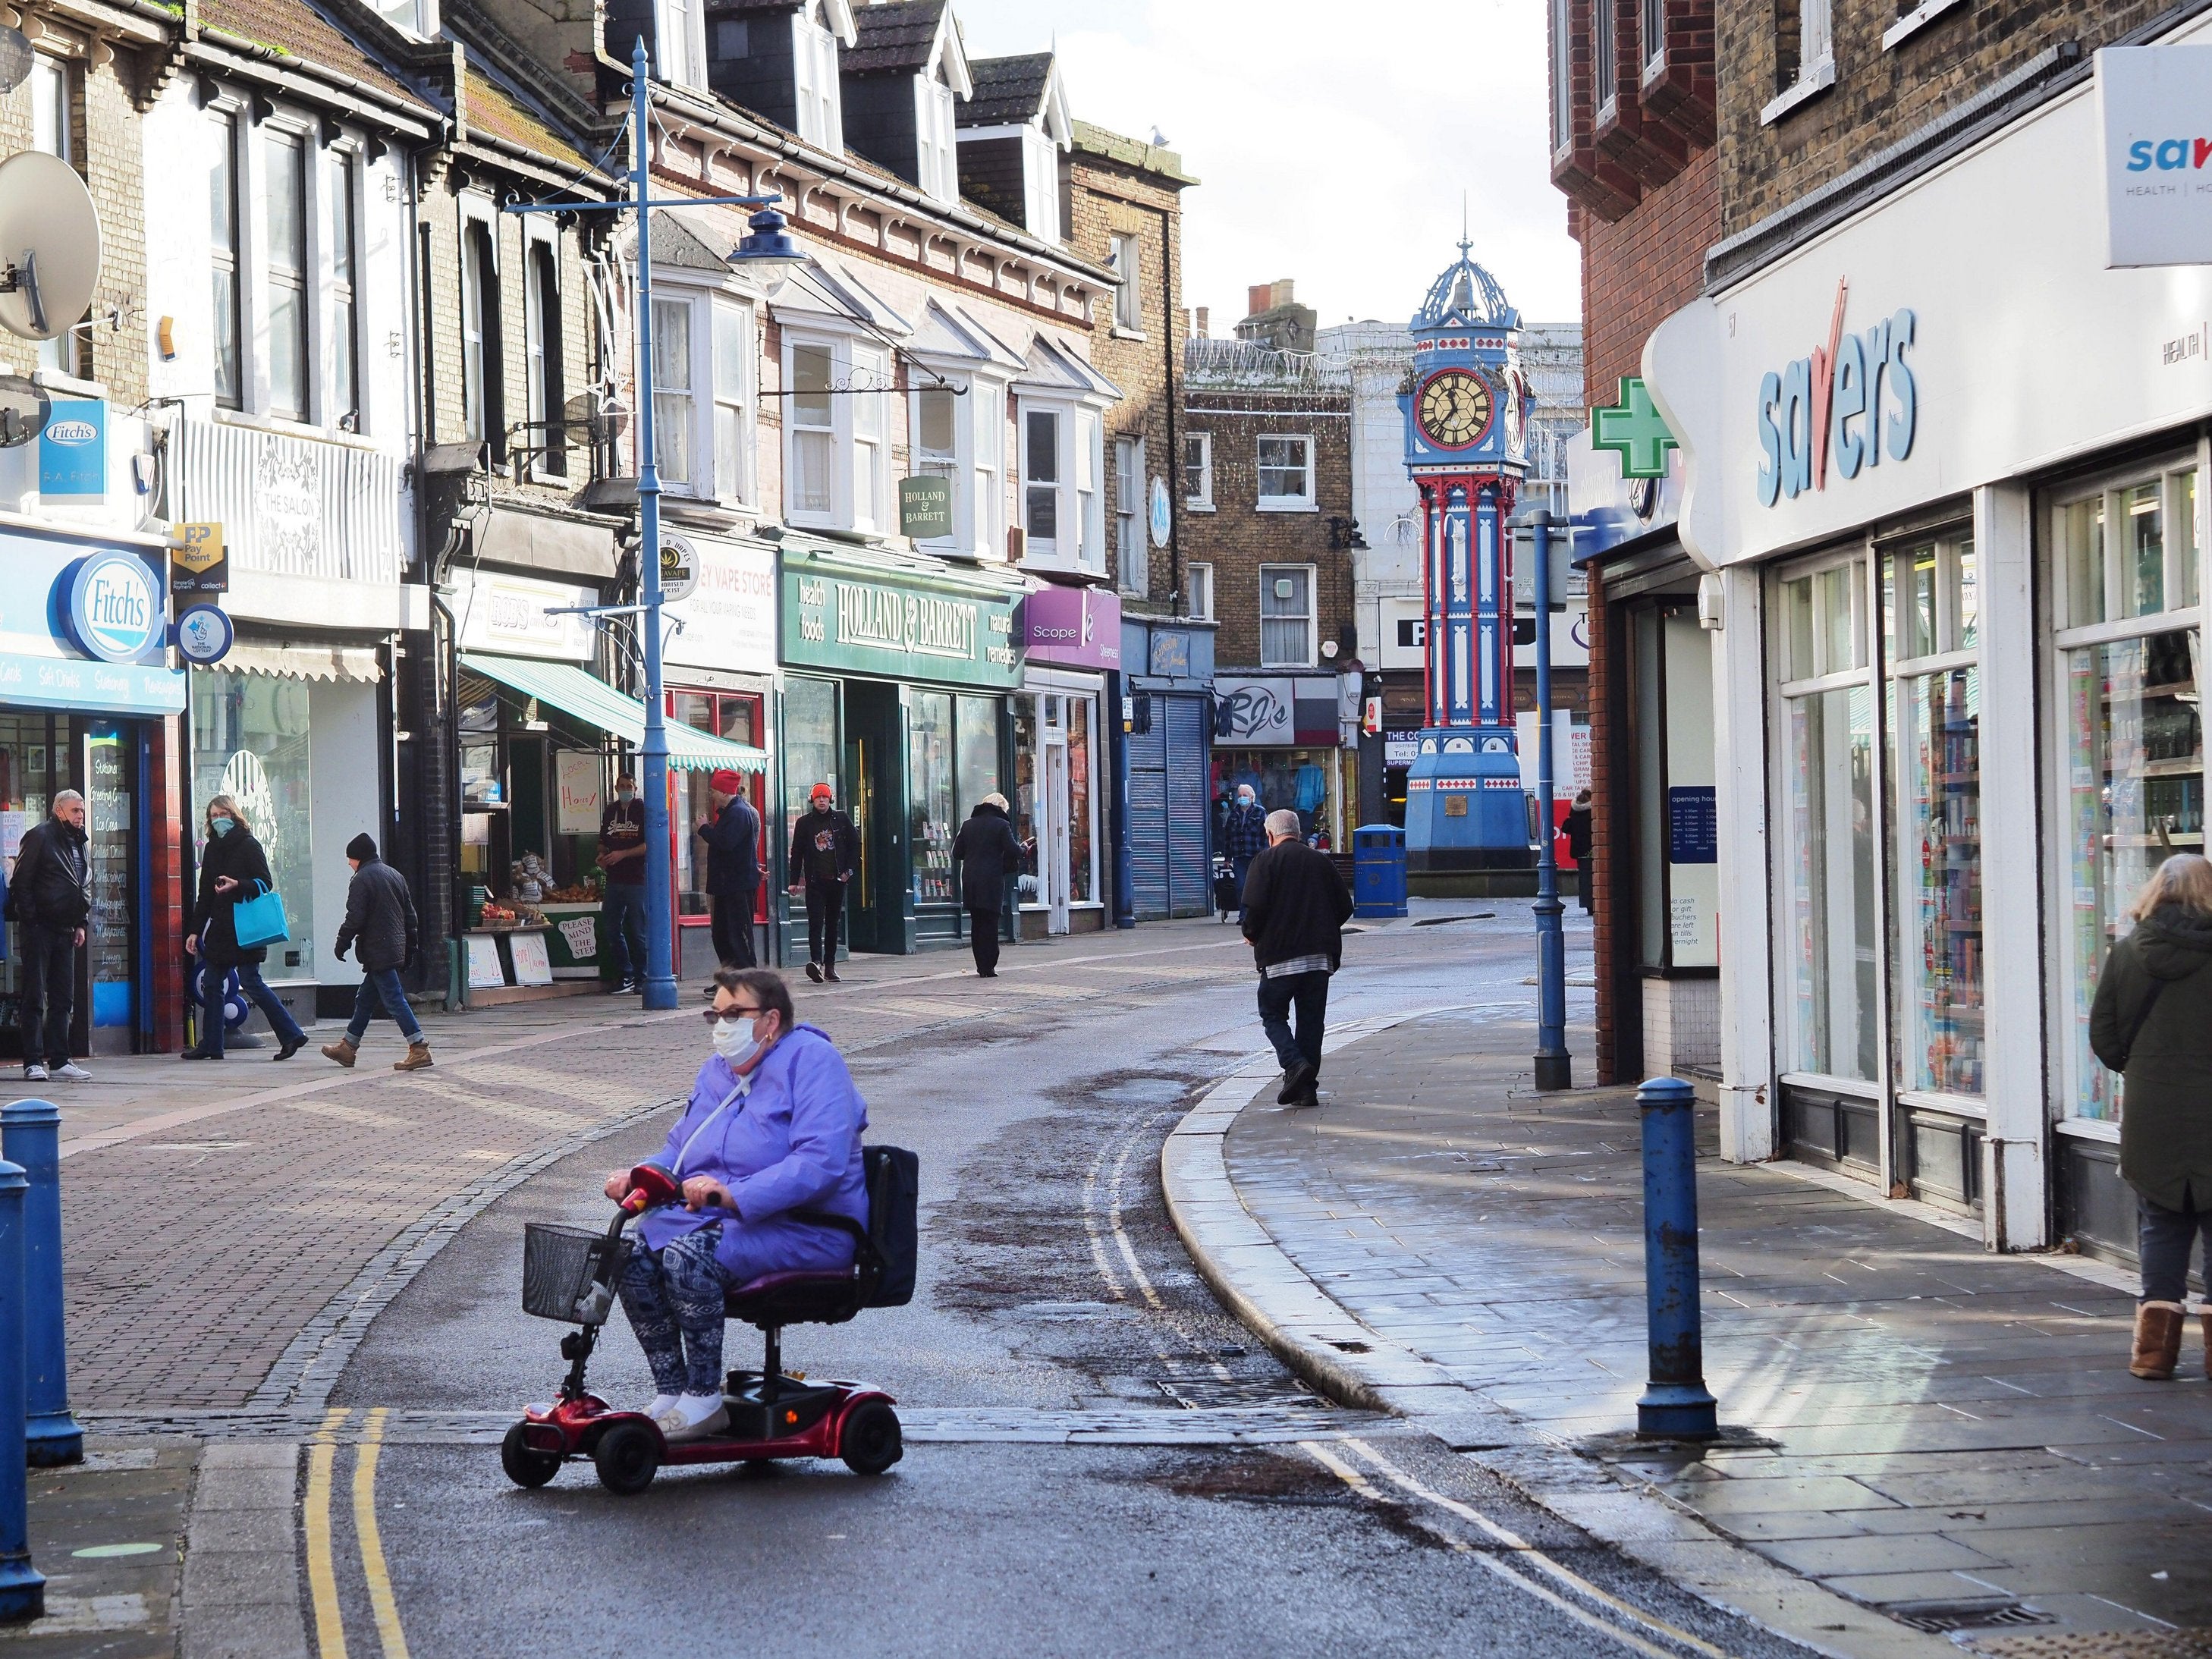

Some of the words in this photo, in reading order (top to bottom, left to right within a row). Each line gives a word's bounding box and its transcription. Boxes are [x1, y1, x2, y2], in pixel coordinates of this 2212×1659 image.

[2126, 185, 2176, 196] HEALTH
[2163, 332, 2199, 365] HEALTH
[1757, 275, 1915, 509] savers
[52, 425, 92, 438] Fitch's
[905, 491, 945, 503] HOLLAND
[265, 493, 281, 512] THE
[284, 495, 315, 517] SALON
[921, 501, 929, 511] &
[906, 511, 944, 523] BARRETT
[184, 544, 202, 555] Pay
[184, 553, 211, 562] Point
[381, 552, 391, 571] 70
[715, 566, 739, 592] VAPE
[743, 570, 771, 596] STORE
[798, 577, 826, 607] health
[93, 579, 144, 627] Fitch's
[690, 598, 701, 613] FOR
[492, 596, 529, 630] ROB'S
[799, 612, 825, 642] foods
[835, 583, 903, 643] HOLLAND
[903, 594, 918, 653] &
[917, 598, 977, 660] BARRETT
[988, 611, 1013, 634] natural
[1033, 625, 1077, 640] Scope
[985, 641, 1016, 665] remedies
[1227, 692, 1287, 739] RJ's
[1386, 731, 1405, 740] THE
[95, 816, 105, 831] Ice
[562, 919, 593, 930] PLEASE
[568, 926, 592, 940] MIND
[573, 938, 592, 947] THE
[574, 946, 595, 956] STEP
[102, 951, 122, 970] Lottery
